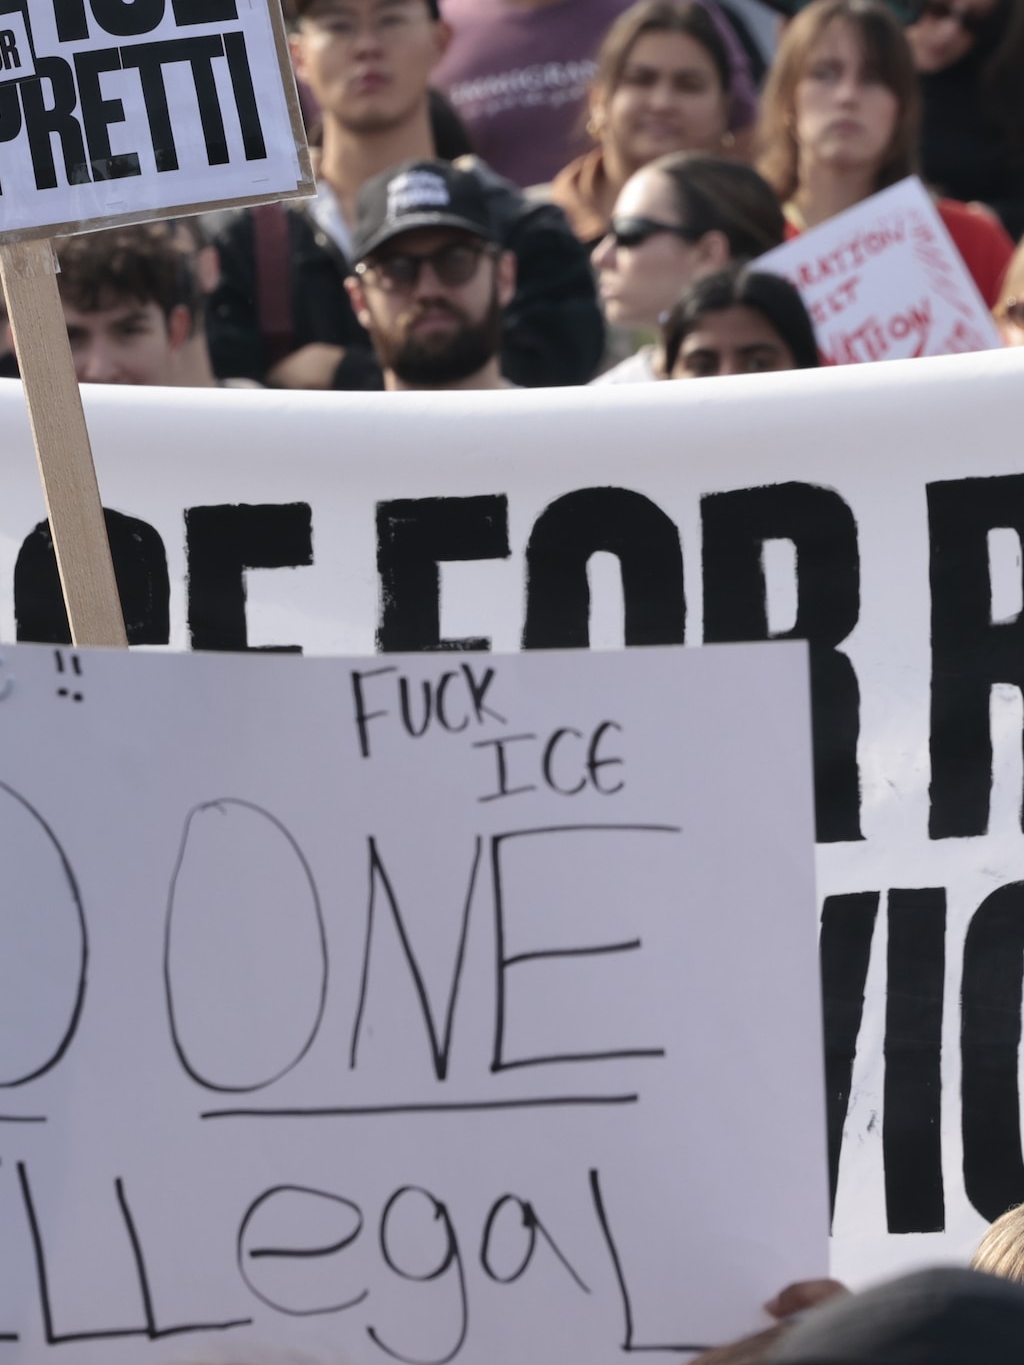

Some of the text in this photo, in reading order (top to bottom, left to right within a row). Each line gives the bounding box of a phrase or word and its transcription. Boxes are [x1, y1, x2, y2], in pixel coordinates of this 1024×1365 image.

[788, 217, 907, 291] RATION
[351, 662, 508, 758] FUCK
[472, 720, 626, 802] ICE
[163, 797, 683, 1092] ONE
